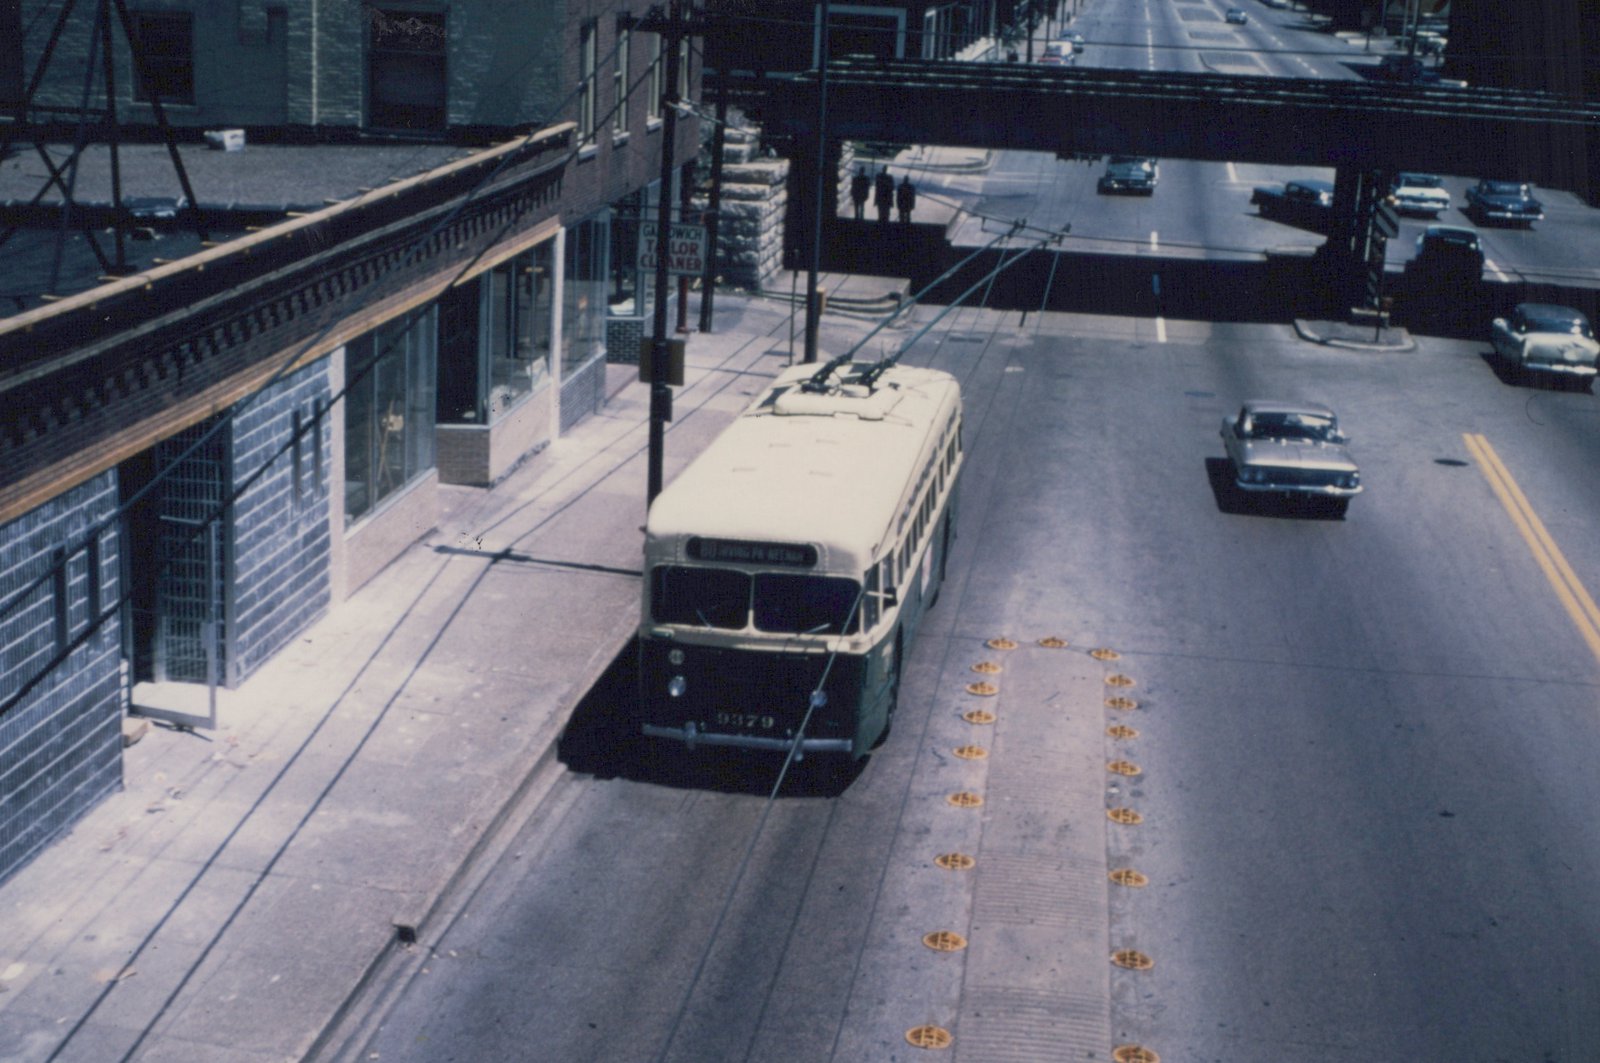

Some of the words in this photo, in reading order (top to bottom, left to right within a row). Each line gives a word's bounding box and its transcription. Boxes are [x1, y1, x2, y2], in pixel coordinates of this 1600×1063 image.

[645, 239, 699, 256] TLOR
[640, 253, 702, 271] CLANER
[718, 713, 774, 728] 9379
